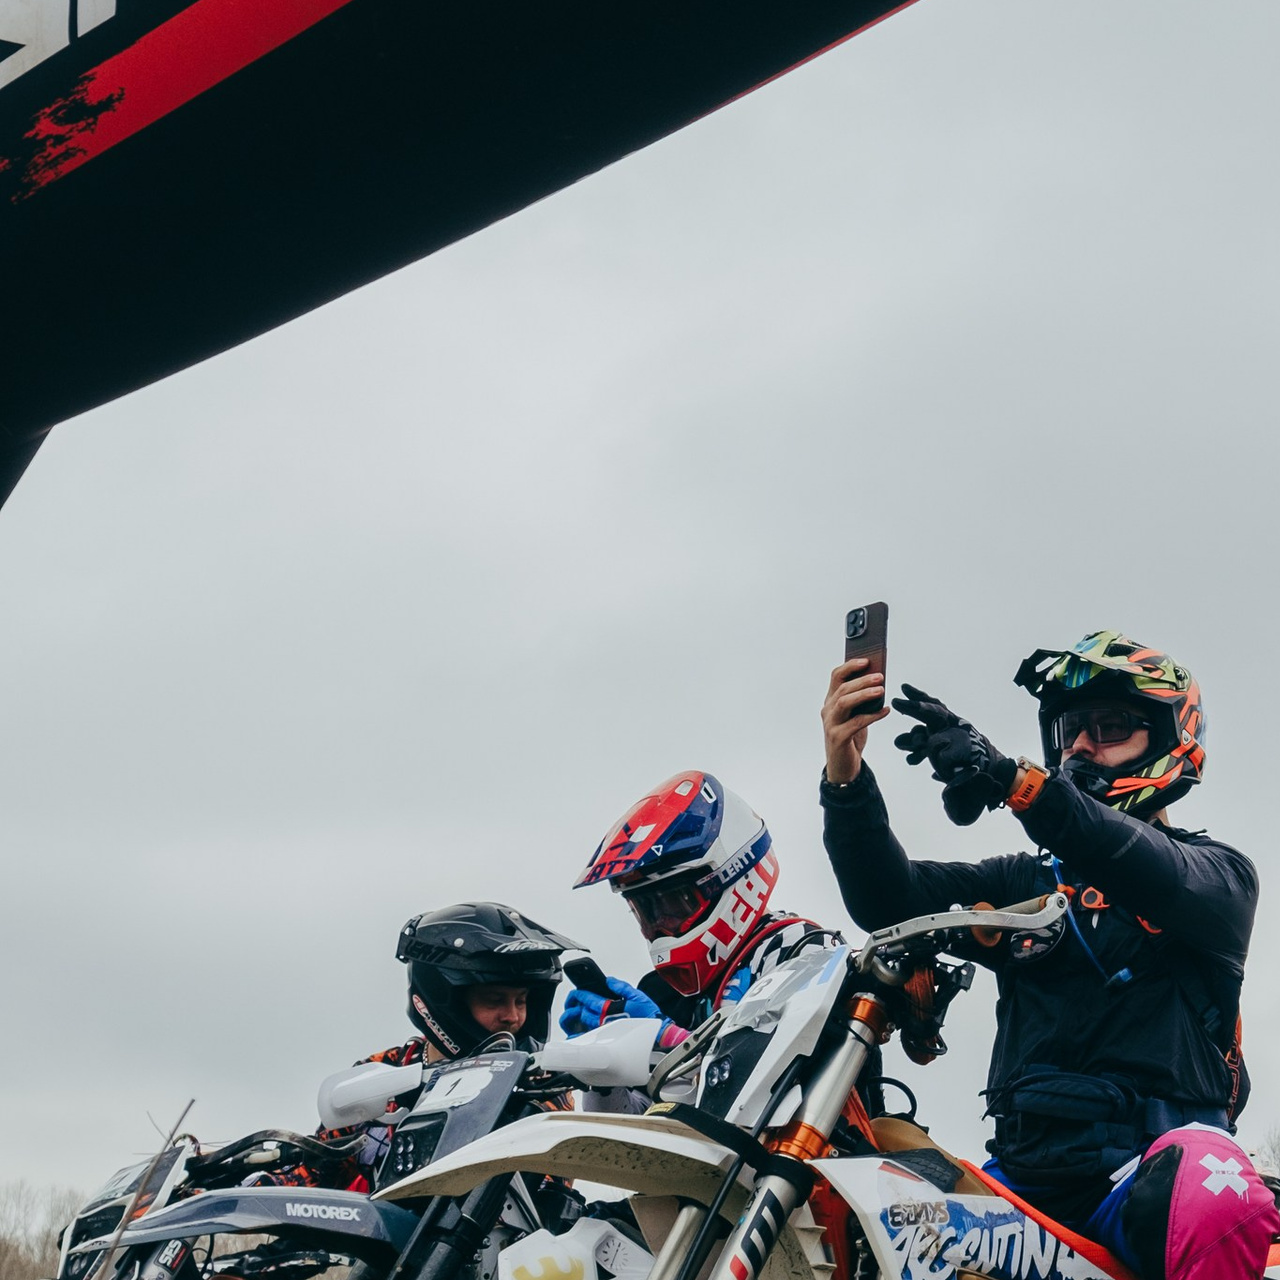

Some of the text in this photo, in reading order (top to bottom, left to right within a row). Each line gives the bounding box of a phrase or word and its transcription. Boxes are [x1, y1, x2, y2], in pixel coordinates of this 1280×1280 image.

[717, 846, 757, 884] LEATT
[444, 1076, 463, 1097] 1
[285, 1201, 363, 1223] MOTOREX
[157, 1239, 183, 1269] SES
